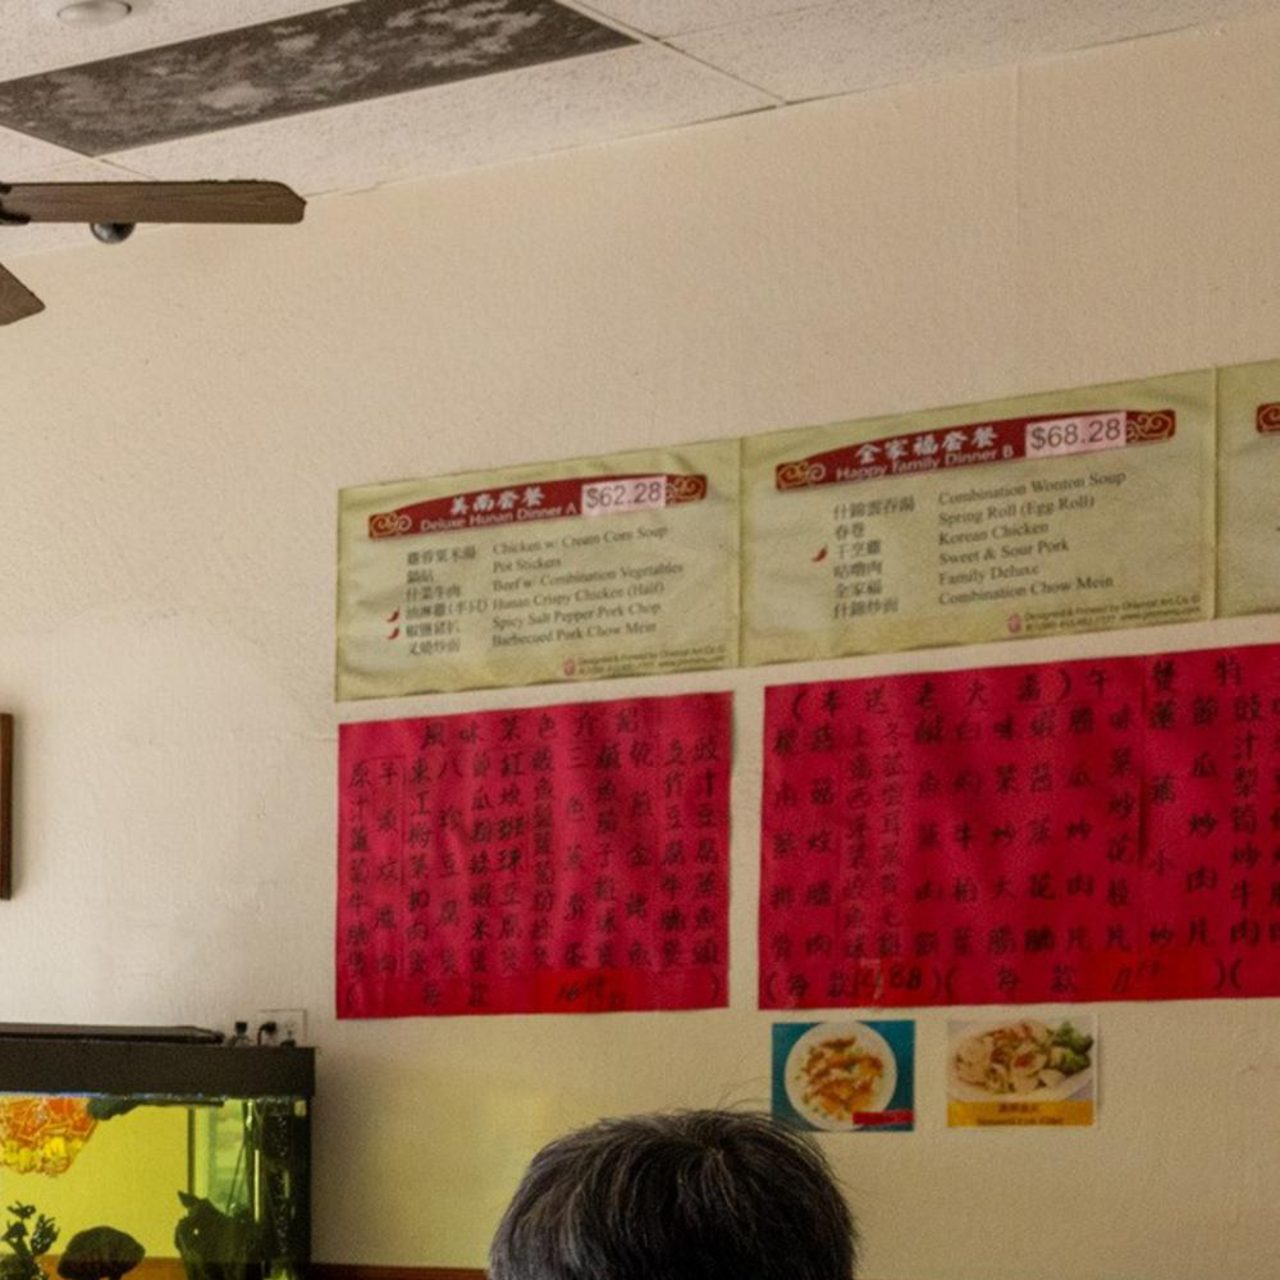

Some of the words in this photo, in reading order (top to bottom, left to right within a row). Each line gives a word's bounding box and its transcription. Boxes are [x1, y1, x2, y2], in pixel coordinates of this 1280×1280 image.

[1030, 417, 1123, 452] $68.28
[836, 461, 887, 482] Happy
[890, 454, 940, 477] Family
[944, 447, 999, 468] Dinner
[1002, 445, 1015, 461] B
[585, 480, 662, 510] $62.28
[940, 482, 1028, 505] Combination
[1030, 474, 1087, 494] Wonton
[1089, 469, 1128, 491] Soup
[420, 516, 466, 534] Deluxe
[469, 510, 514, 528] Hunan
[517, 504, 563, 523] Dinner
[567, 502, 577, 516] A
[940, 509, 984, 530] Spring
[987, 502, 1018, 522] Roll
[1020, 498, 1056, 521] (Egg
[1058, 494, 1096, 515] Roll)
[493, 539, 541, 555] Chicken
[562, 531, 599, 549] Cream
[602, 526, 634, 543] Corn
[637, 523, 669, 541] Soup
[939, 528, 989, 547] Korean
[992, 520, 1050, 541] Chicken
[493, 559, 513, 573] Pot
[516, 555, 563, 570] Stickers
[939, 548, 980, 567] Sweet
[984, 546, 997, 561] &
[1000, 542, 1035, 560] Sour
[1037, 537, 1070, 555] Pork
[493, 576, 521, 591] Beef
[539, 567, 617, 587] Combination
[619, 561, 684, 580] Vegetables
[939, 568, 988, 588] Family
[990, 563, 1041, 582] Deluxe
[492, 595, 530, 611] Hunan
[533, 591, 572, 609] Crispy
[575, 584, 624, 602] Chicken
[626, 581, 665, 599] (Half)
[939, 587, 1028, 609] Combination
[1030, 578, 1073, 598] Chow
[1074, 573, 1115, 591] Mein
[492, 613, 526, 632] Spicy
[528, 609, 551, 625] Salt
[553, 605, 592, 625] Pepper
[594, 603, 625, 619] Pork
[627, 601, 662, 618] Chop
[492, 631, 554, 649] Barbecued
[557, 628, 584, 643] Pork
[586, 624, 622, 640] Chow
[624, 620, 658, 635] Mein
